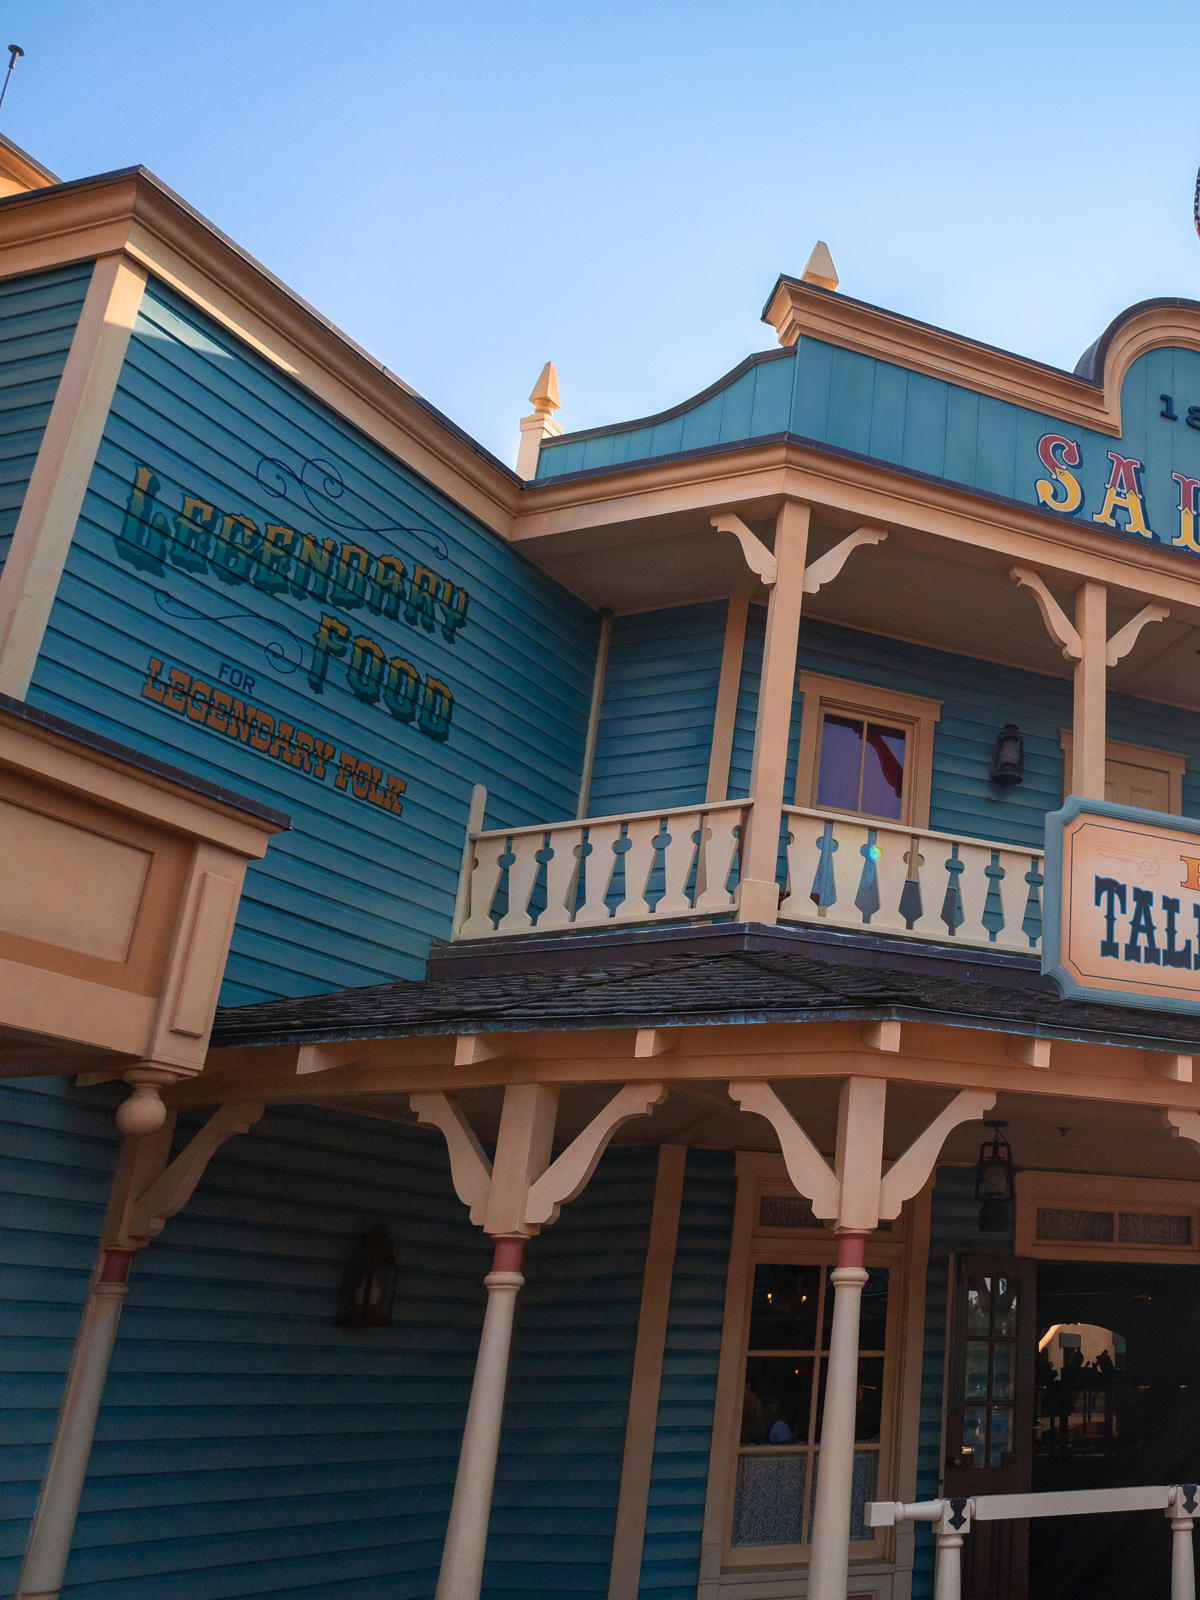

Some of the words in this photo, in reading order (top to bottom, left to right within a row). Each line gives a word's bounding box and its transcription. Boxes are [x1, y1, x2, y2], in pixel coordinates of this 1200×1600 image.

[113, 461, 469, 645] LEGENDARY
[140, 655, 335, 783] LEGENDARY
[334, 749, 408, 817] FOLK
[217, 661, 256, 695] FOR
[307, 611, 455, 743] FOOD
